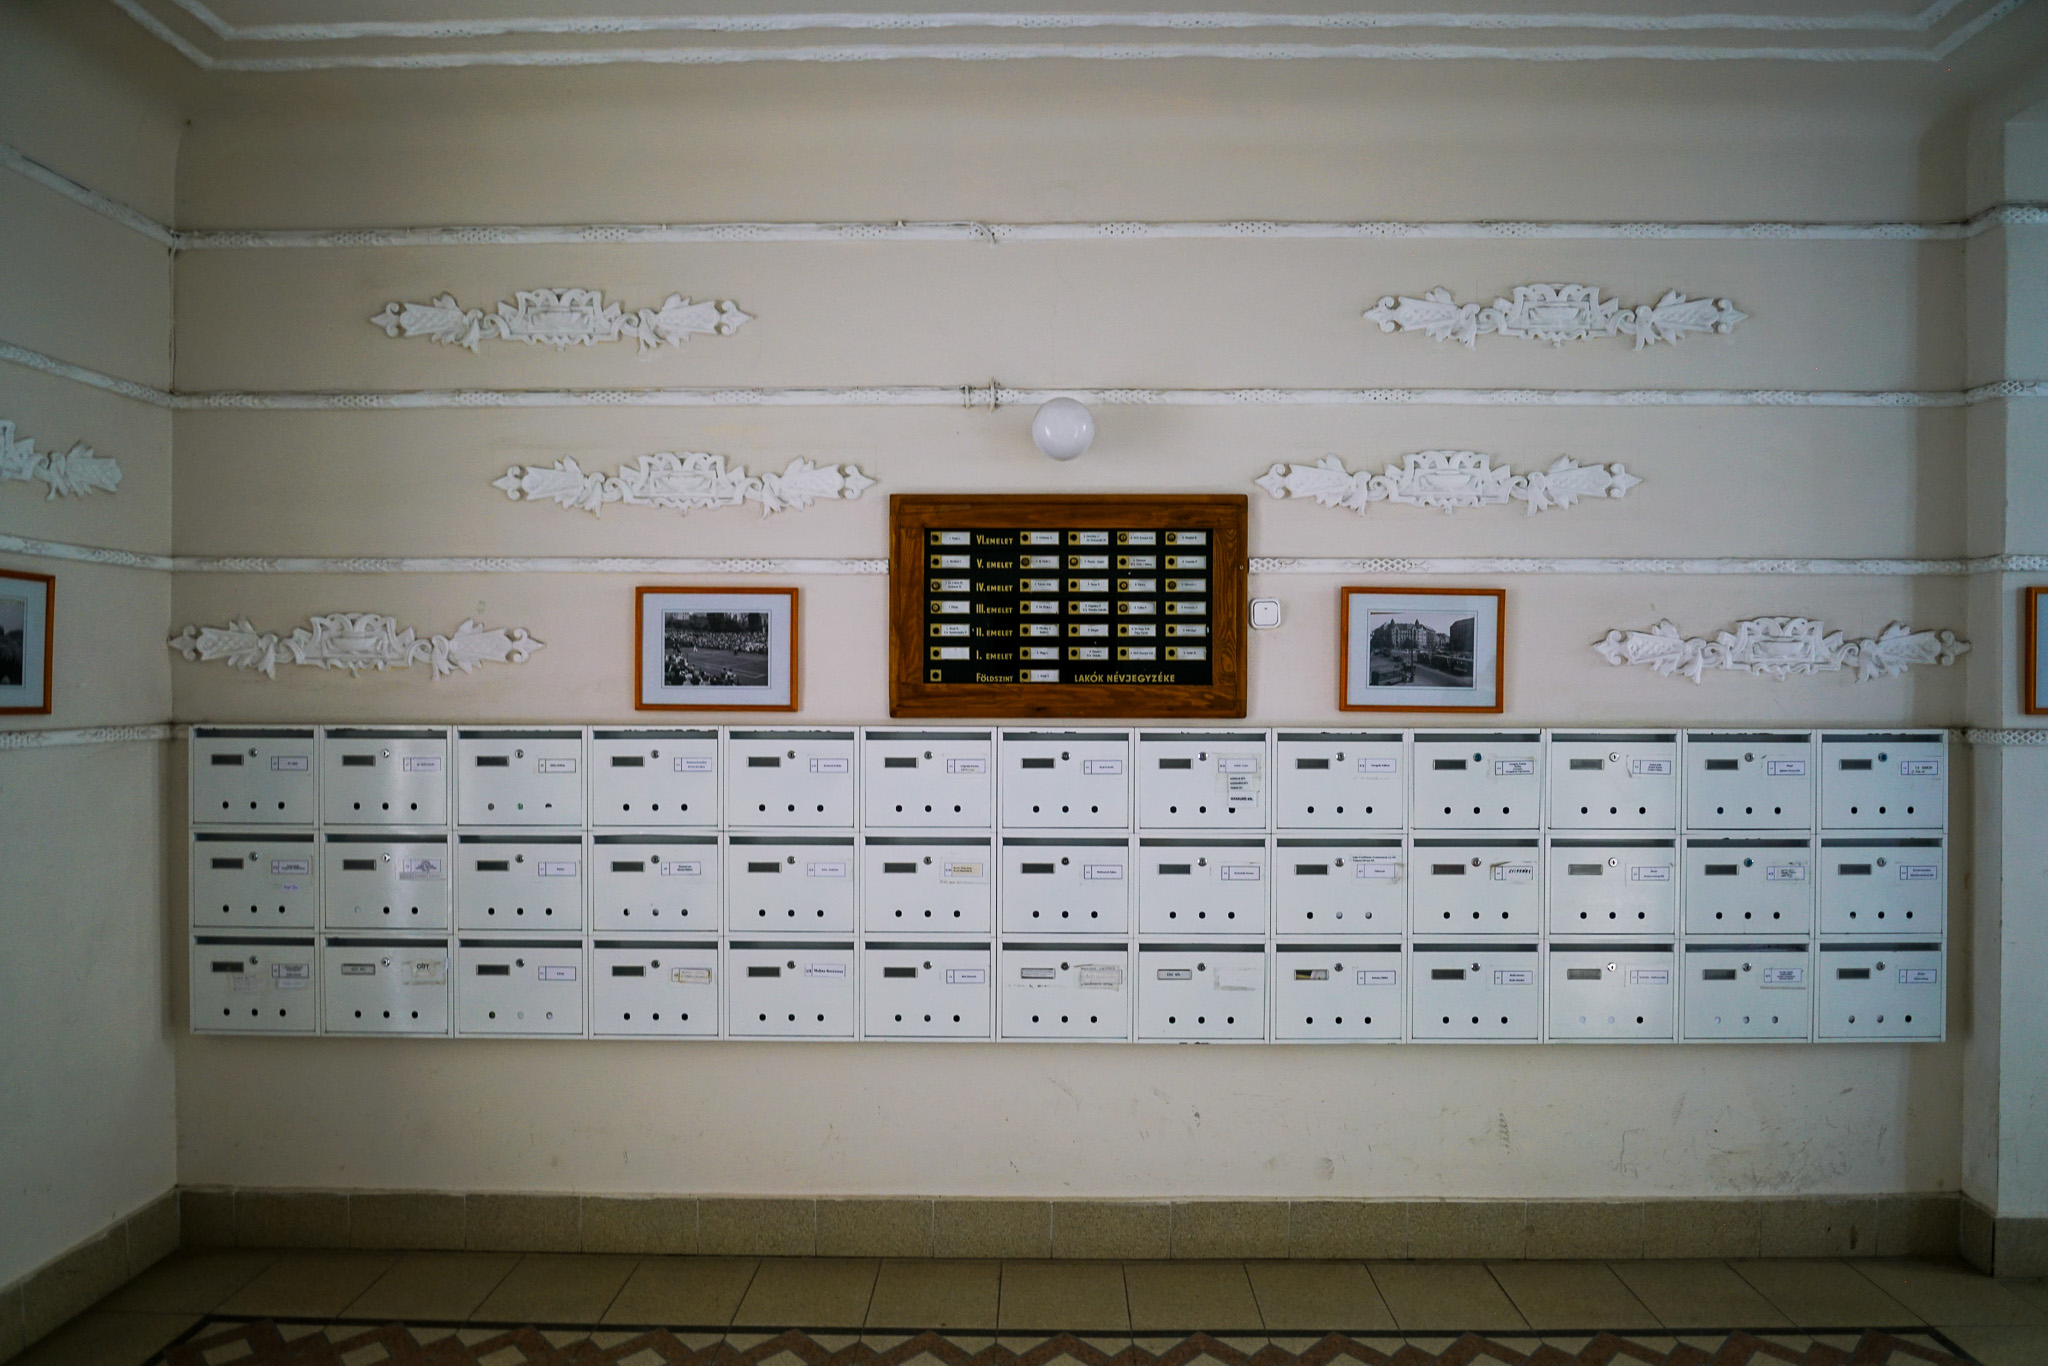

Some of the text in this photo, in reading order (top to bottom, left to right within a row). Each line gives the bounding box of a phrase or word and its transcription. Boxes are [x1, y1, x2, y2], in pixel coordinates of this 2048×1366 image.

[986, 537, 1013, 545] EMELET
[976, 558, 1013, 569] V. EMELET
[976, 582, 986, 592] IV.
[976, 603, 986, 614] III.
[976, 627, 984, 637] II.
[976, 649, 982, 660] I.
[1073, 671, 1175, 682] LAKÓK NÉVJEGYZÉKE
